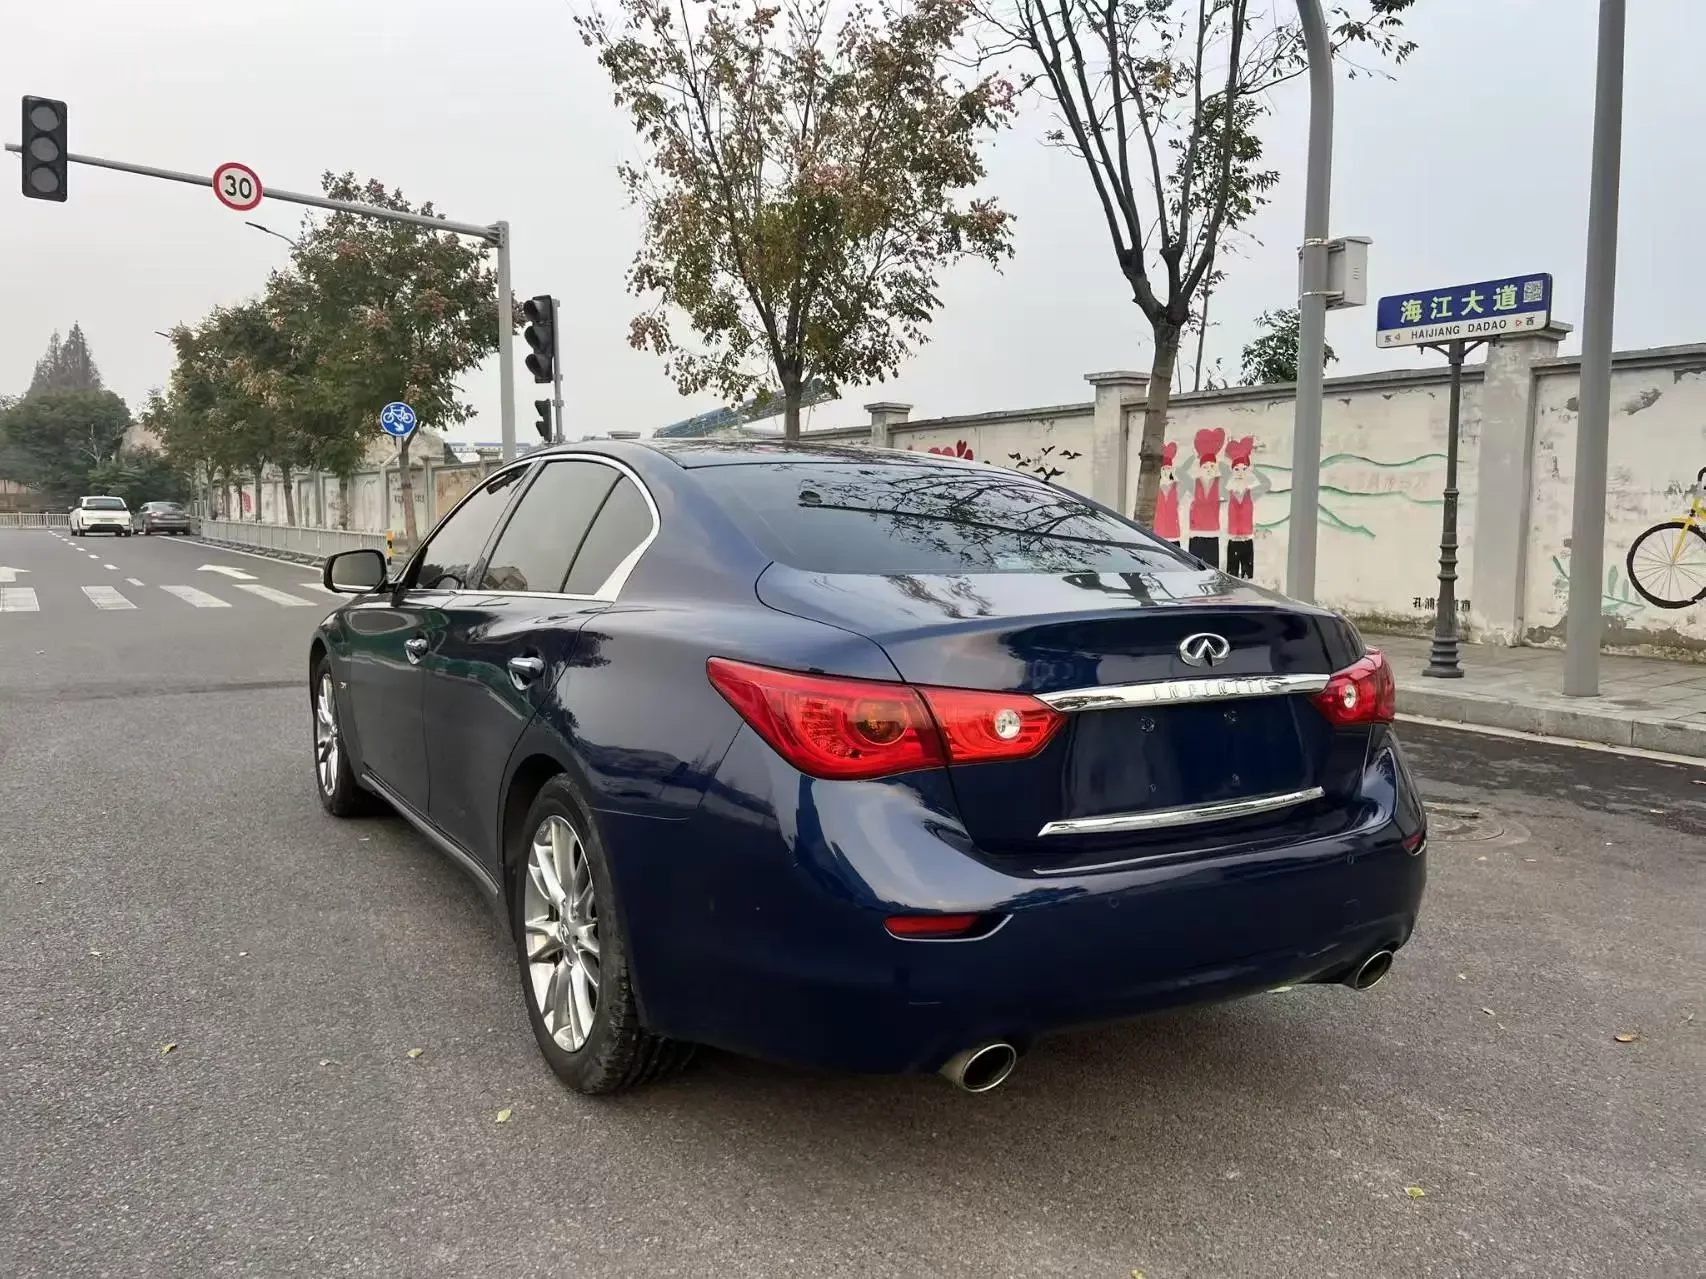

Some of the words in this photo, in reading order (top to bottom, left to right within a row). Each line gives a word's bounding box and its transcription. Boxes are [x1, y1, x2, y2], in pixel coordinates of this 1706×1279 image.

[224, 174, 252, 199] 30
[1400, 284, 1518, 324] 海江大道
[1411, 325, 1460, 340] HAIJIANG
[1468, 319, 1507, 333] DADAO
[1525, 316, 1536, 326] 西
